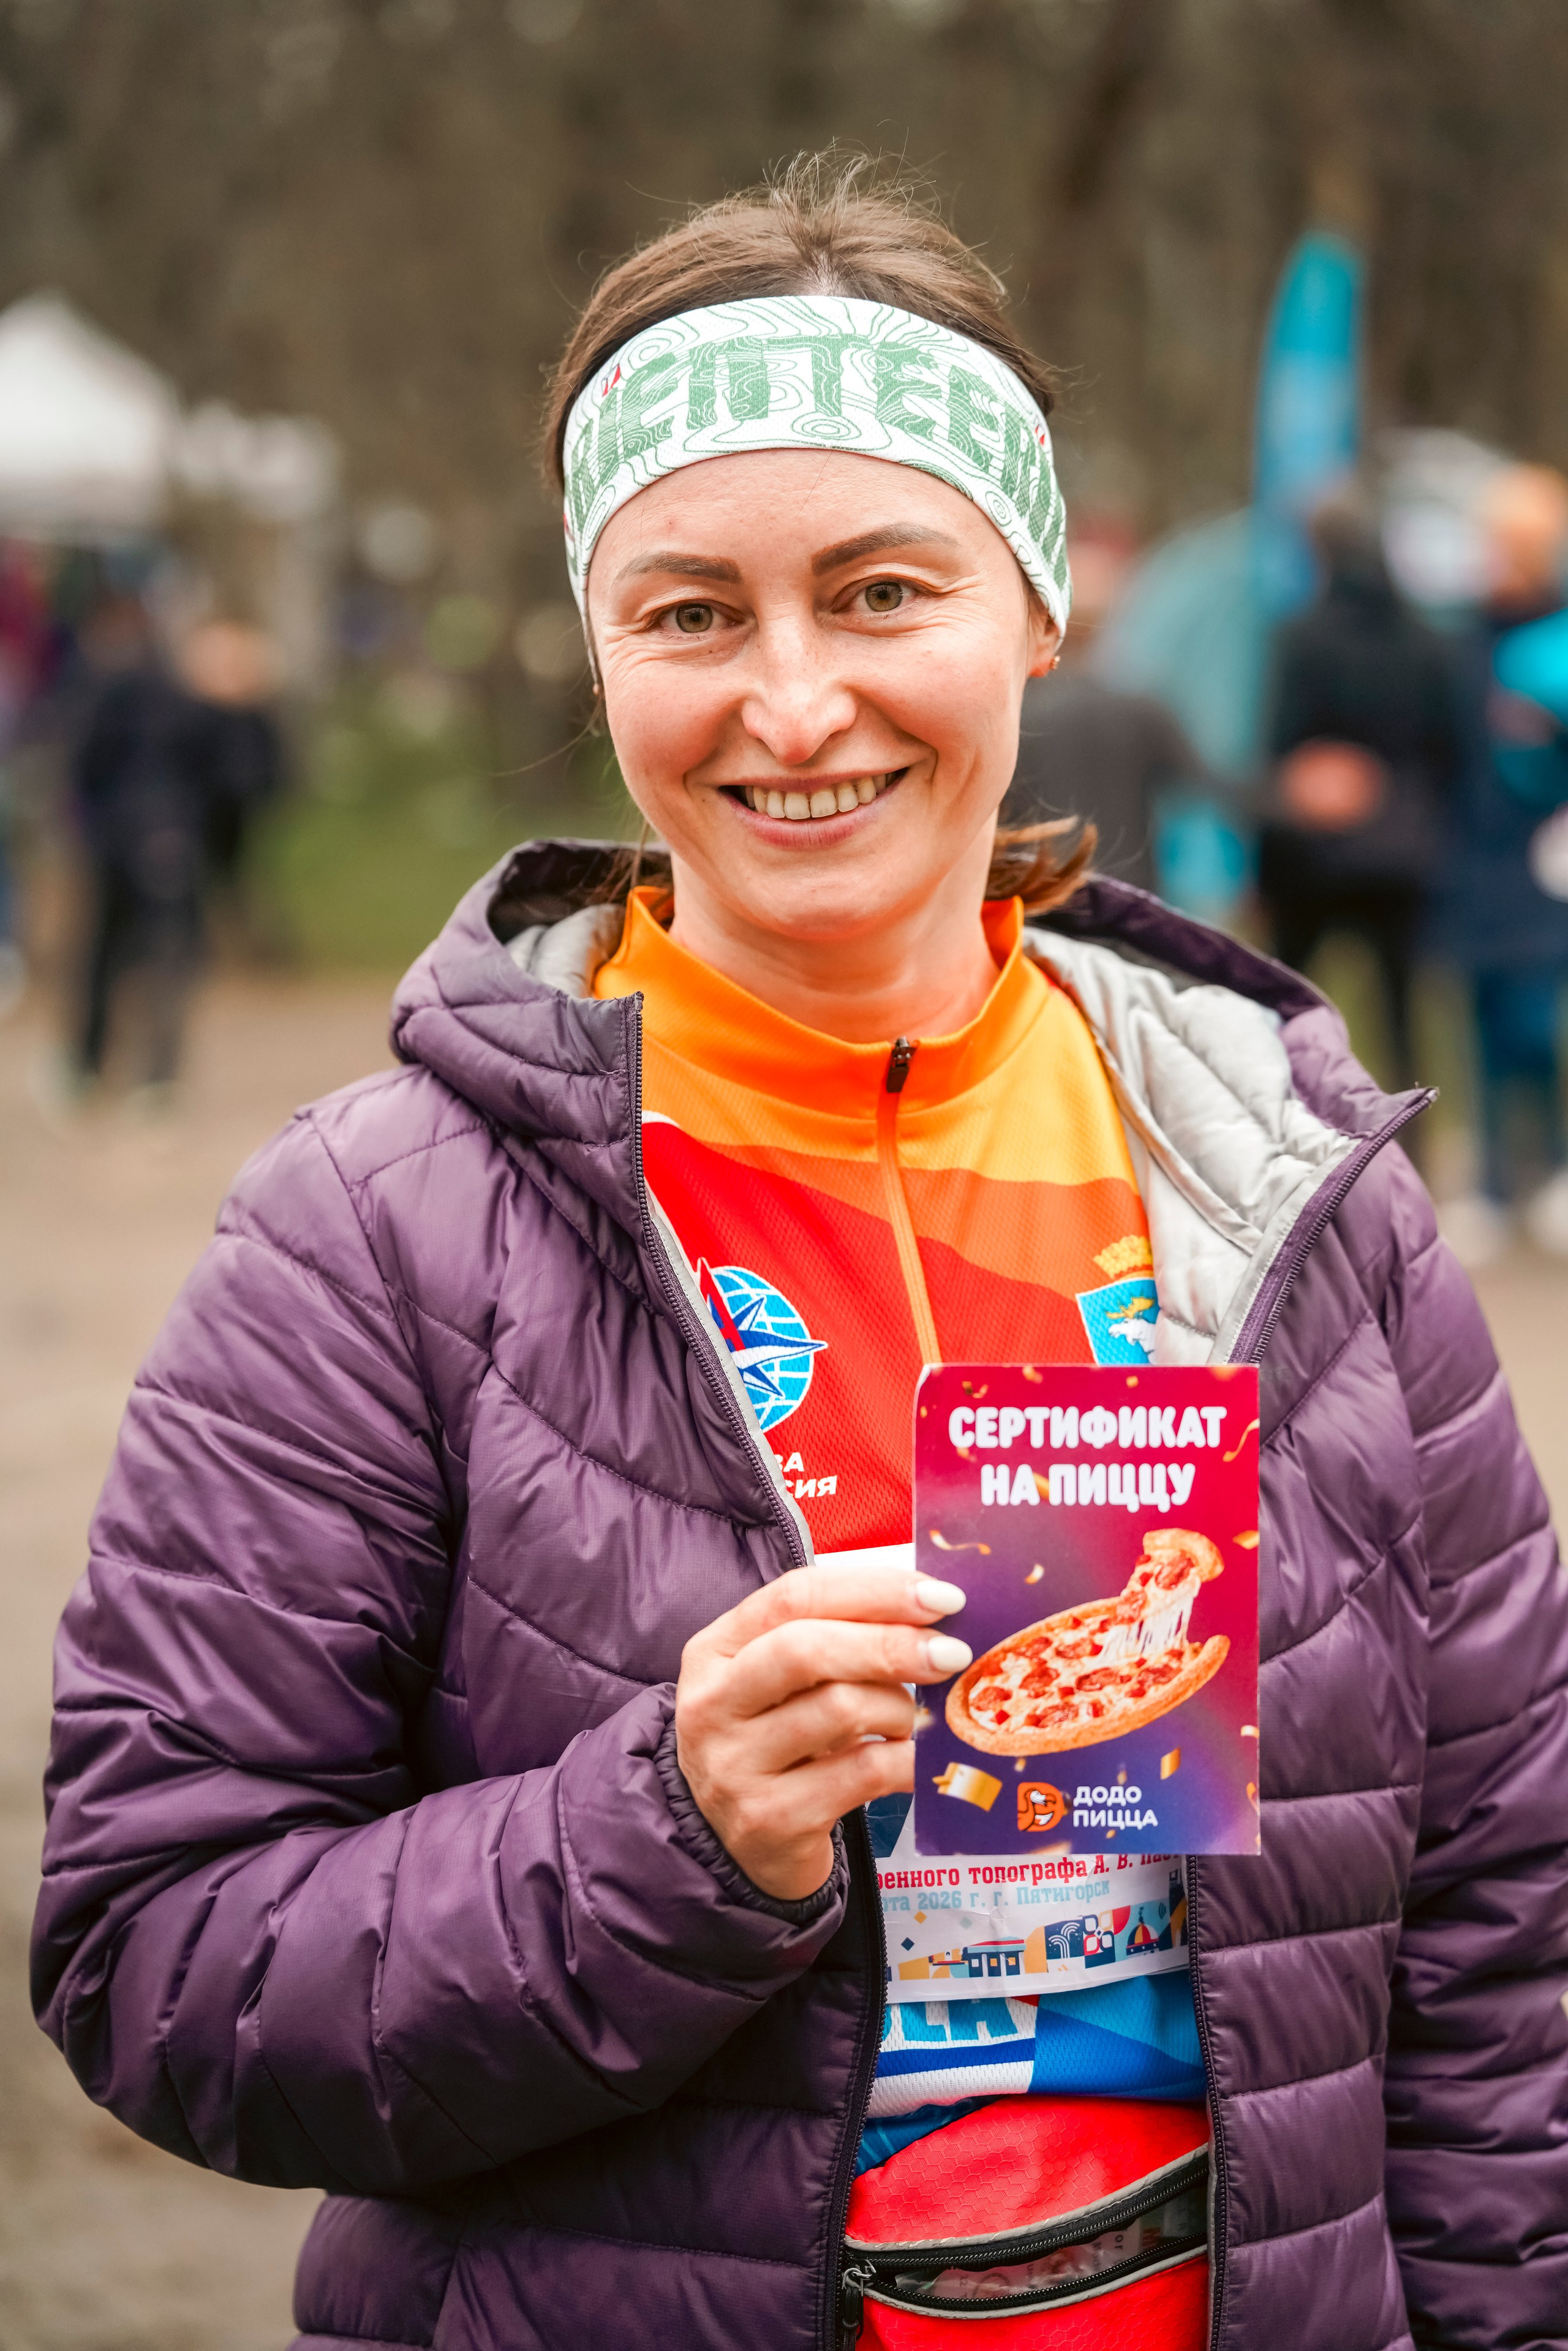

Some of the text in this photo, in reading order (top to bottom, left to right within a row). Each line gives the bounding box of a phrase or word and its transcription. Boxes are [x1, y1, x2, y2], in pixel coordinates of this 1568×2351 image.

[948, 1405, 1227, 1449] СЕРТИФИКАТ
[981, 1463, 1196, 1513] НА ПИЦЦУ
[1073, 1786, 1142, 1807] ДОДО
[1073, 1809, 1158, 1830] ПИЦЦА
[968, 1857, 1087, 1886] топографа
[918, 1890, 962, 1910] 2026
[970, 1892, 986, 1908] г.
[993, 1891, 1008, 1906] г.
[1016, 1880, 1109, 1904] Пятигорск
